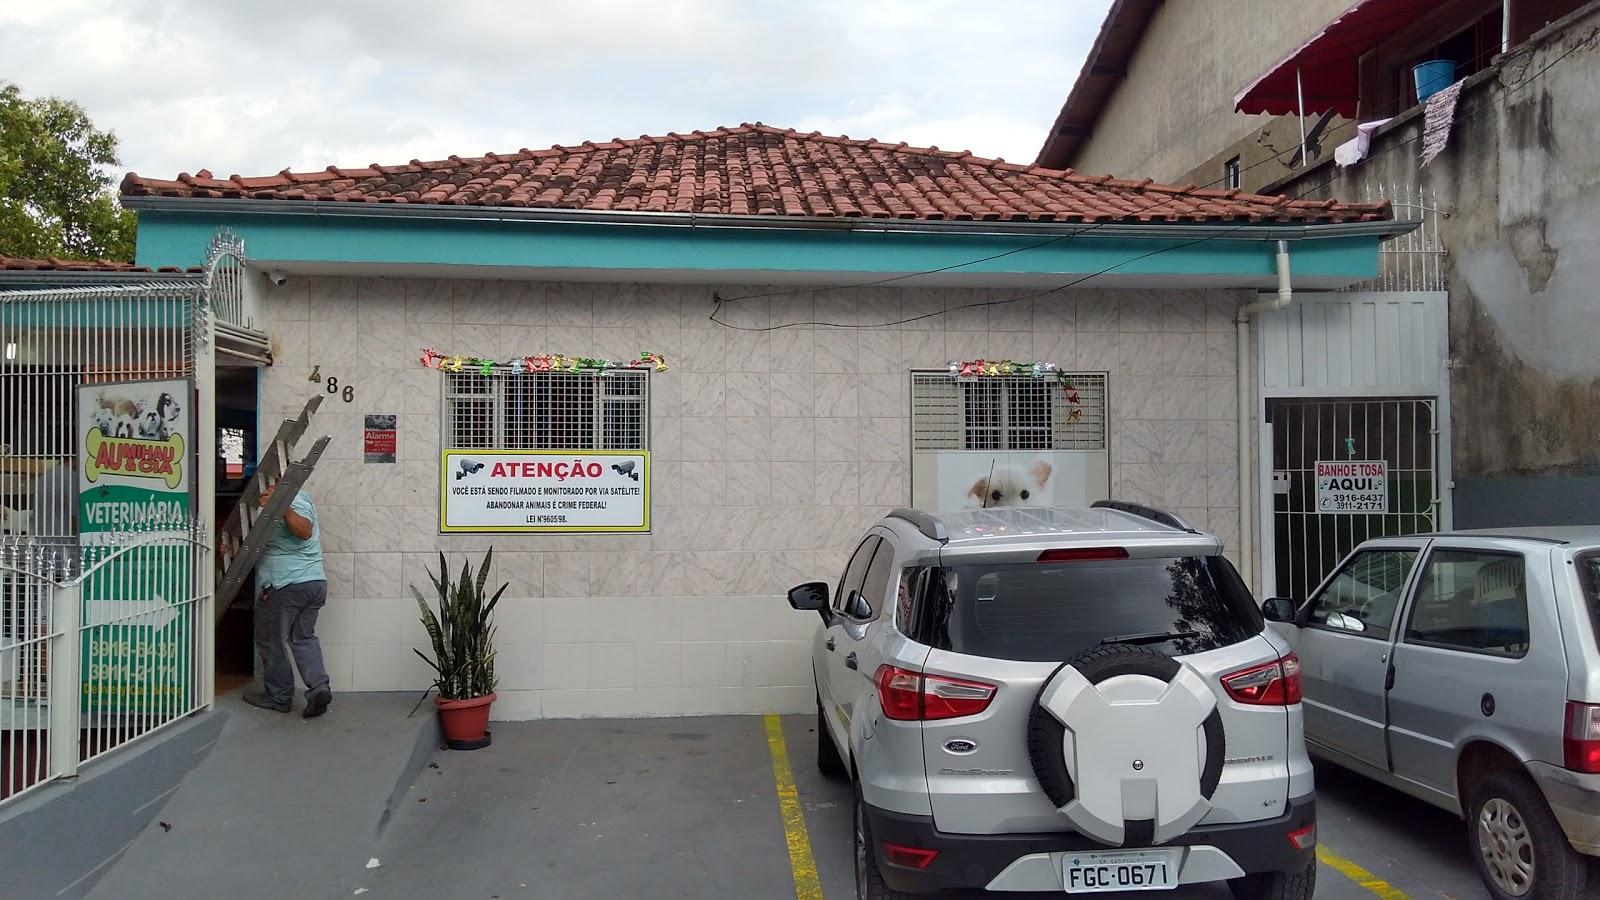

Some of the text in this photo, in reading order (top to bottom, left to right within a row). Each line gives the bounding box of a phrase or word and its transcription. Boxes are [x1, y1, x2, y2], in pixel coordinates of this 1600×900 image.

[366, 431, 395, 440] Alarme
[138, 460, 173, 475] CIA
[490, 459, 603, 482] ATENÇÃO
[1318, 464, 1384, 476] BANHO E TOSA
[1328, 478, 1372, 491] AQUI
[452, 485, 640, 496] VOCÊ ESTÁ SENDO FILMADO E MONITORADO POR VIA SATÉLITE!
[1333, 494, 1384, 502] 3916-6437
[85, 494, 183, 524] VETERINÁRIA
[486, 499, 607, 510] ABANDONAR ANIMAIS É CRIME FEDERAL!
[1336, 501, 1383, 510] 3911-2171
[526, 514, 536, 523] LEI
